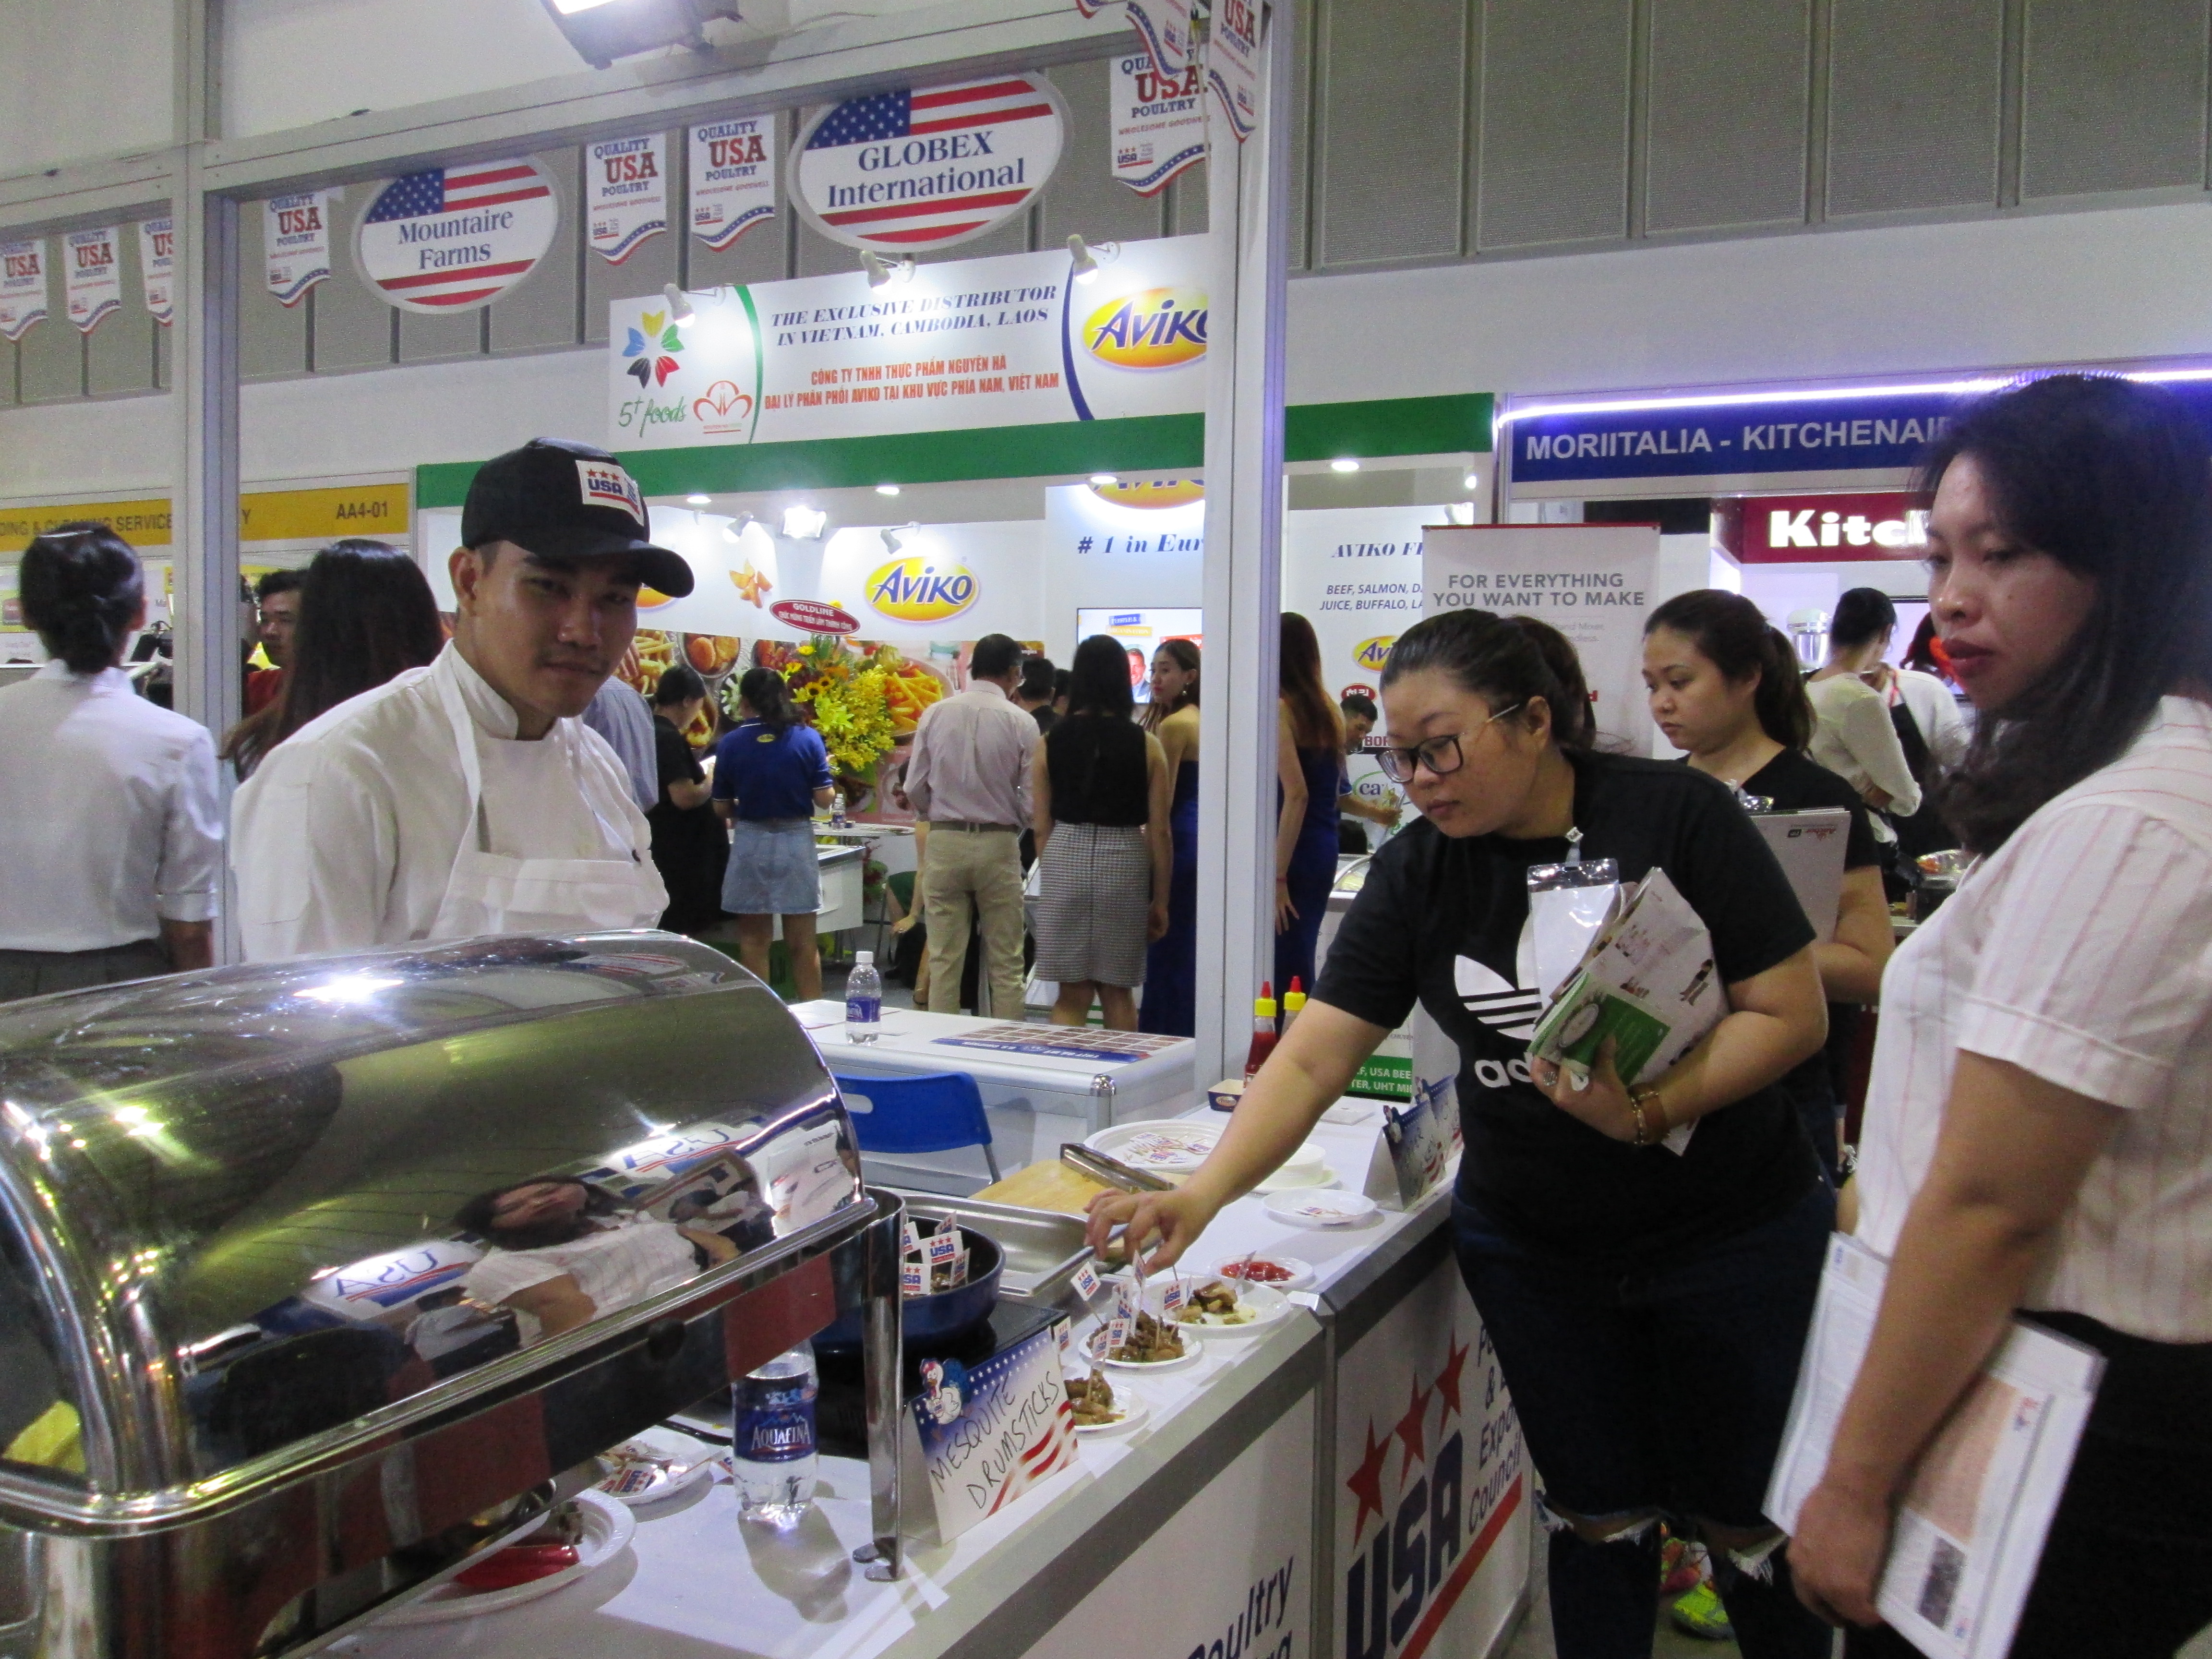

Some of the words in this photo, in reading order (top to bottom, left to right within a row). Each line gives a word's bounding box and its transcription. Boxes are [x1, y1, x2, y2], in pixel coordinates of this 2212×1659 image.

[1135, 64, 1208, 103] USA
[1131, 98, 1196, 119] POULTRY
[697, 120, 757, 142] QUALITY
[594, 138, 649, 160] QUALITY
[708, 135, 767, 168] USA
[858, 131, 994, 171] GLOBEX
[604, 151, 658, 183] USA
[705, 165, 757, 181] POULTRY
[602, 180, 650, 197] POULTRY
[828, 157, 1025, 208] International
[278, 206, 323, 235] USA
[398, 208, 514, 245] Mountaire
[5, 253, 41, 277] USA
[76, 242, 113, 267] USA
[419, 243, 492, 270] Farms
[772, 311, 808, 327] THE
[813, 300, 914, 323] EXCLUSIVE
[921, 285, 1057, 312] DISTRIBUTOR
[777, 332, 797, 346] IN
[801, 323, 885, 344] VIETNAM,
[890, 314, 990, 335] CAMBODIA,
[997, 308, 1049, 325] LAOS
[841, 368, 852, 383] TY
[855, 366, 882, 382] TNHH
[1035, 372, 1059, 389] NAM
[1527, 428, 1713, 460] MORIITALIA
[588, 478, 623, 495] USA
[337, 501, 388, 519] AA4-01
[1103, 536, 1114, 553] 1
[1126, 535, 1147, 553] in
[1155, 533, 1204, 552] Eur
[1331, 542, 1395, 558] AVIKO
[1326, 584, 1354, 595] BEEF,
[1358, 583, 1409, 595] SALMON,
[1448, 574, 1487, 588] FOR
[1495, 573, 1623, 588] EVERYTHING
[793, 603, 834, 616] GOLDLINE
[1319, 600, 1353, 611] JUICE,
[1356, 600, 1408, 610] BUFFALO,
[1432, 592, 1475, 606] YOU
[1482, 592, 1543, 606] WANT
[1550, 591, 1577, 606] TO
[1585, 591, 1644, 606] MAKE
[1370, 1067, 1390, 1077] USA
[1393, 1069, 1412, 1079] BEE
[1351, 1079, 1371, 1090] TER,
[1373, 1081, 1395, 1091] UHT
[930, 1243, 954, 1257] USA
[903, 1274, 921, 1285] SA
[1081, 1274, 1094, 1290] USA
[1164, 1290, 1181, 1304] USA
[751, 1419, 811, 1451] AQUAFINA
[930, 1373, 1015, 1492] MESQUITE
[966, 1371, 1059, 1509] DRUMSTICKS
[1479, 1401, 1518, 1471] Expo
[1468, 1428, 1523, 1536] Council
[1346, 1427, 1463, 1659] USA
[1187, 1555, 1294, 1659] oultry
